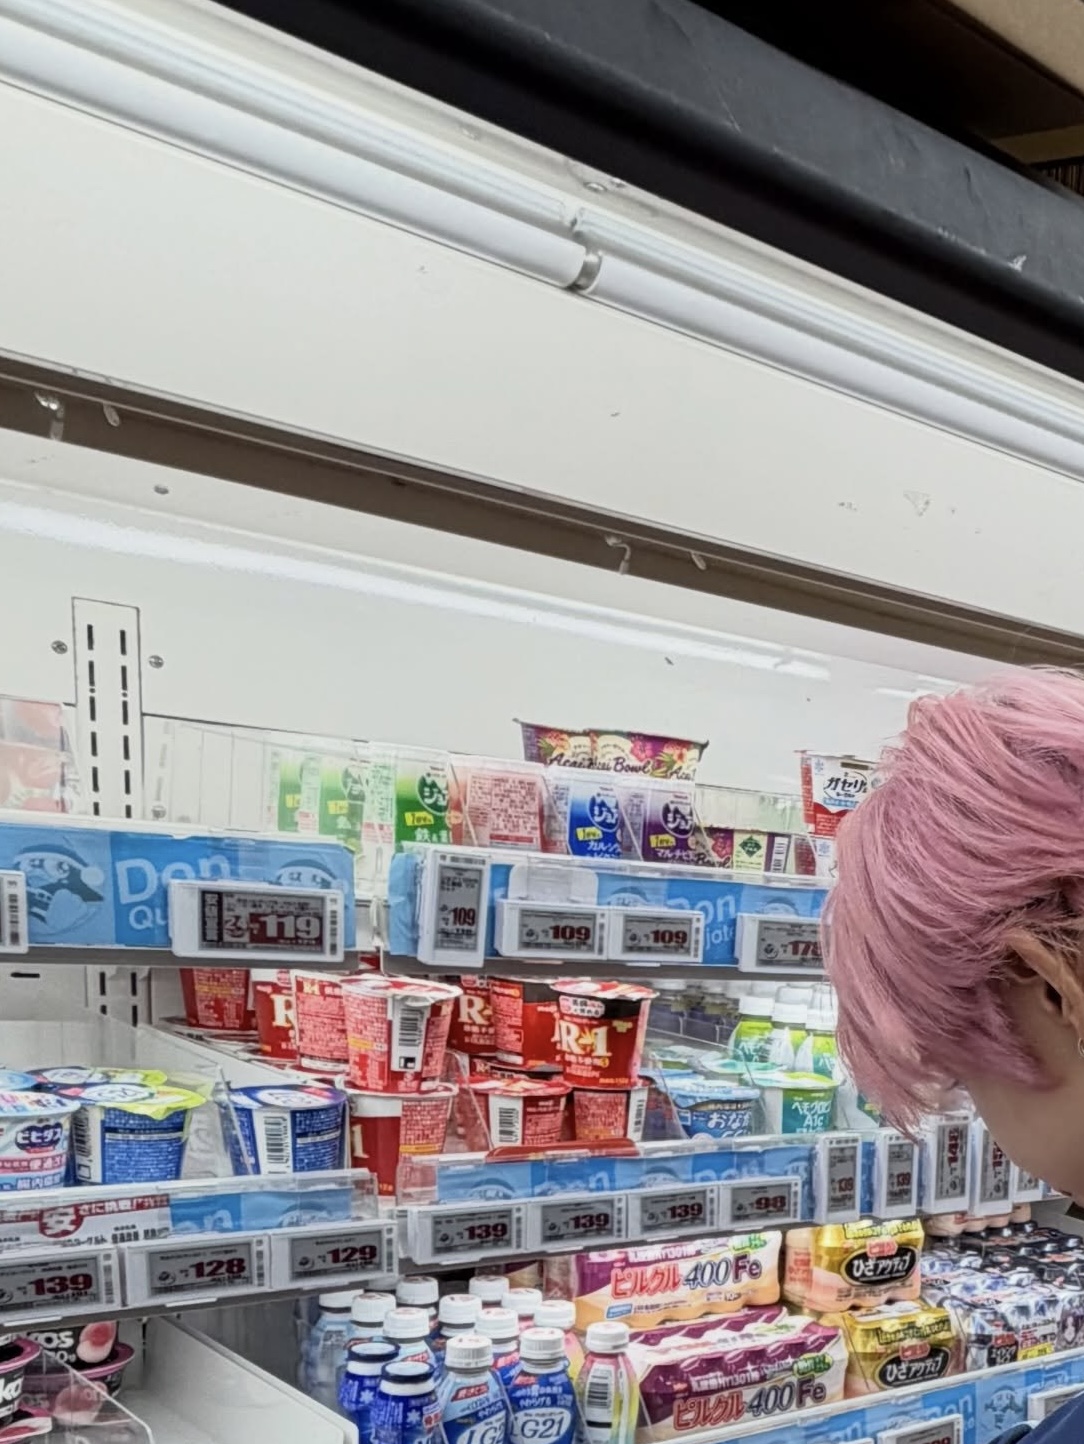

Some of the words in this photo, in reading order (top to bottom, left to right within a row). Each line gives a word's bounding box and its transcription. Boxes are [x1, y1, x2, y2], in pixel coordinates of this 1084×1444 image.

[259, 914, 322, 938] 119
[452, 907, 475, 927] 109
[550, 925, 591, 941] 109
[652, 929, 688, 944] 109
[559, 1019, 612, 1057] R-1
[571, 1212, 610, 1229] 139
[667, 1203, 703, 1220] 139
[465, 1222, 508, 1240] 139
[327, 1245, 378, 1264] 129
[188, 1257, 246, 1278] 128
[611, 1263, 681, 1300] ピルクル
[683, 1258, 731, 1290] 400
[733, 1253, 763, 1285] Fe
[30, 1273, 93, 1296] 139
[673, 1389, 745, 1431] ピルクル
[747, 1381, 794, 1418] 400
[796, 1376, 827, 1408] Fe
